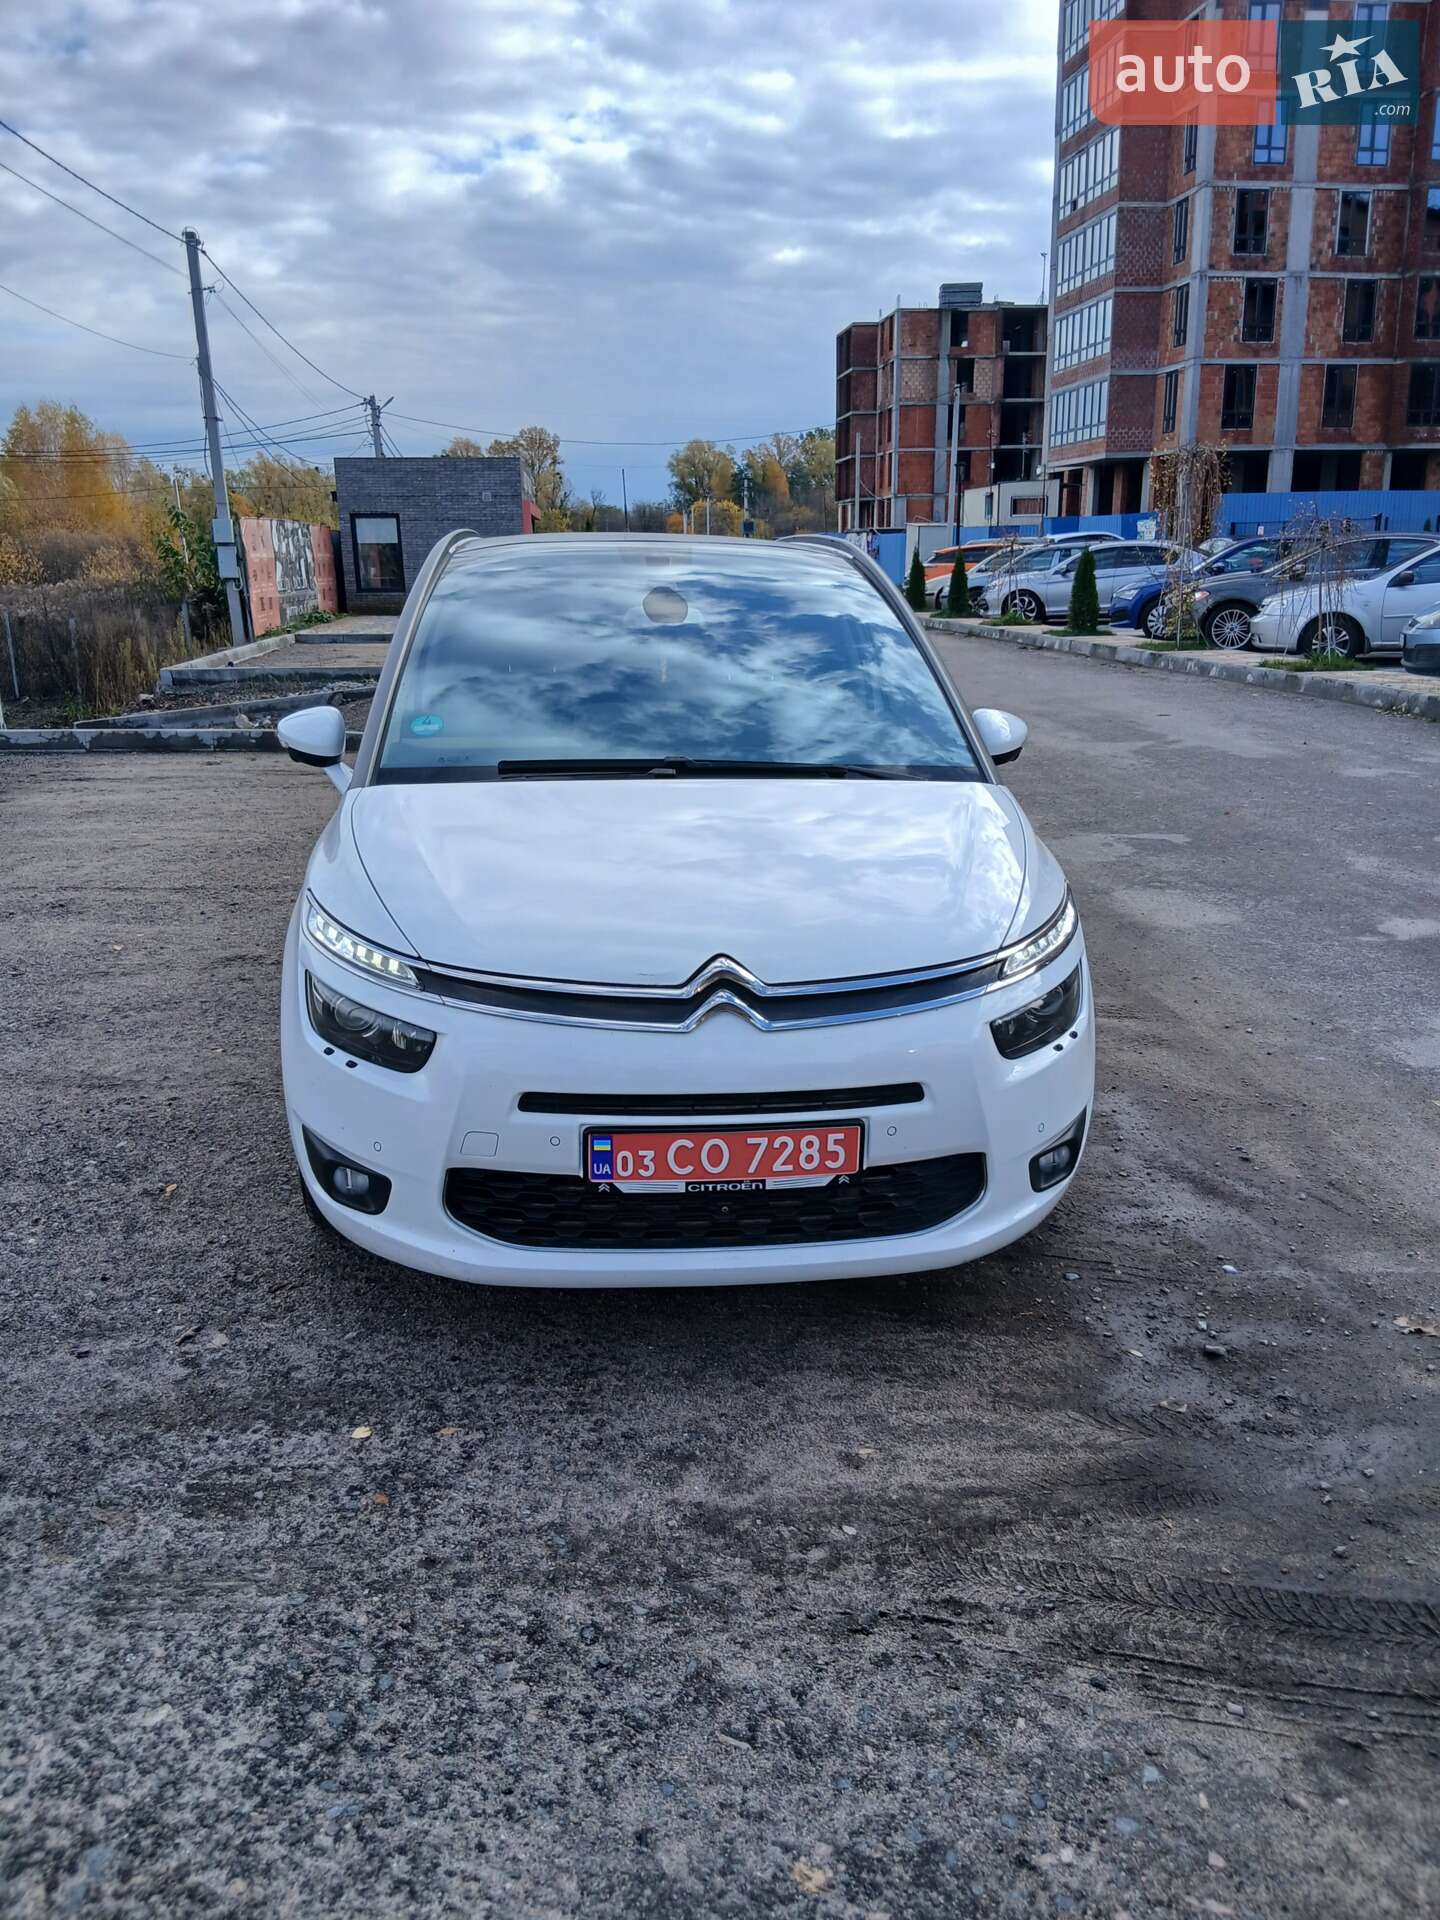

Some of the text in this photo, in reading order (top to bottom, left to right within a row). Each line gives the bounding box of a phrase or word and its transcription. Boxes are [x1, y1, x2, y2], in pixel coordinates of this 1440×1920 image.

[616, 1132, 846, 1177] 03 CO 7285
[593, 1164, 612, 1175] UA
